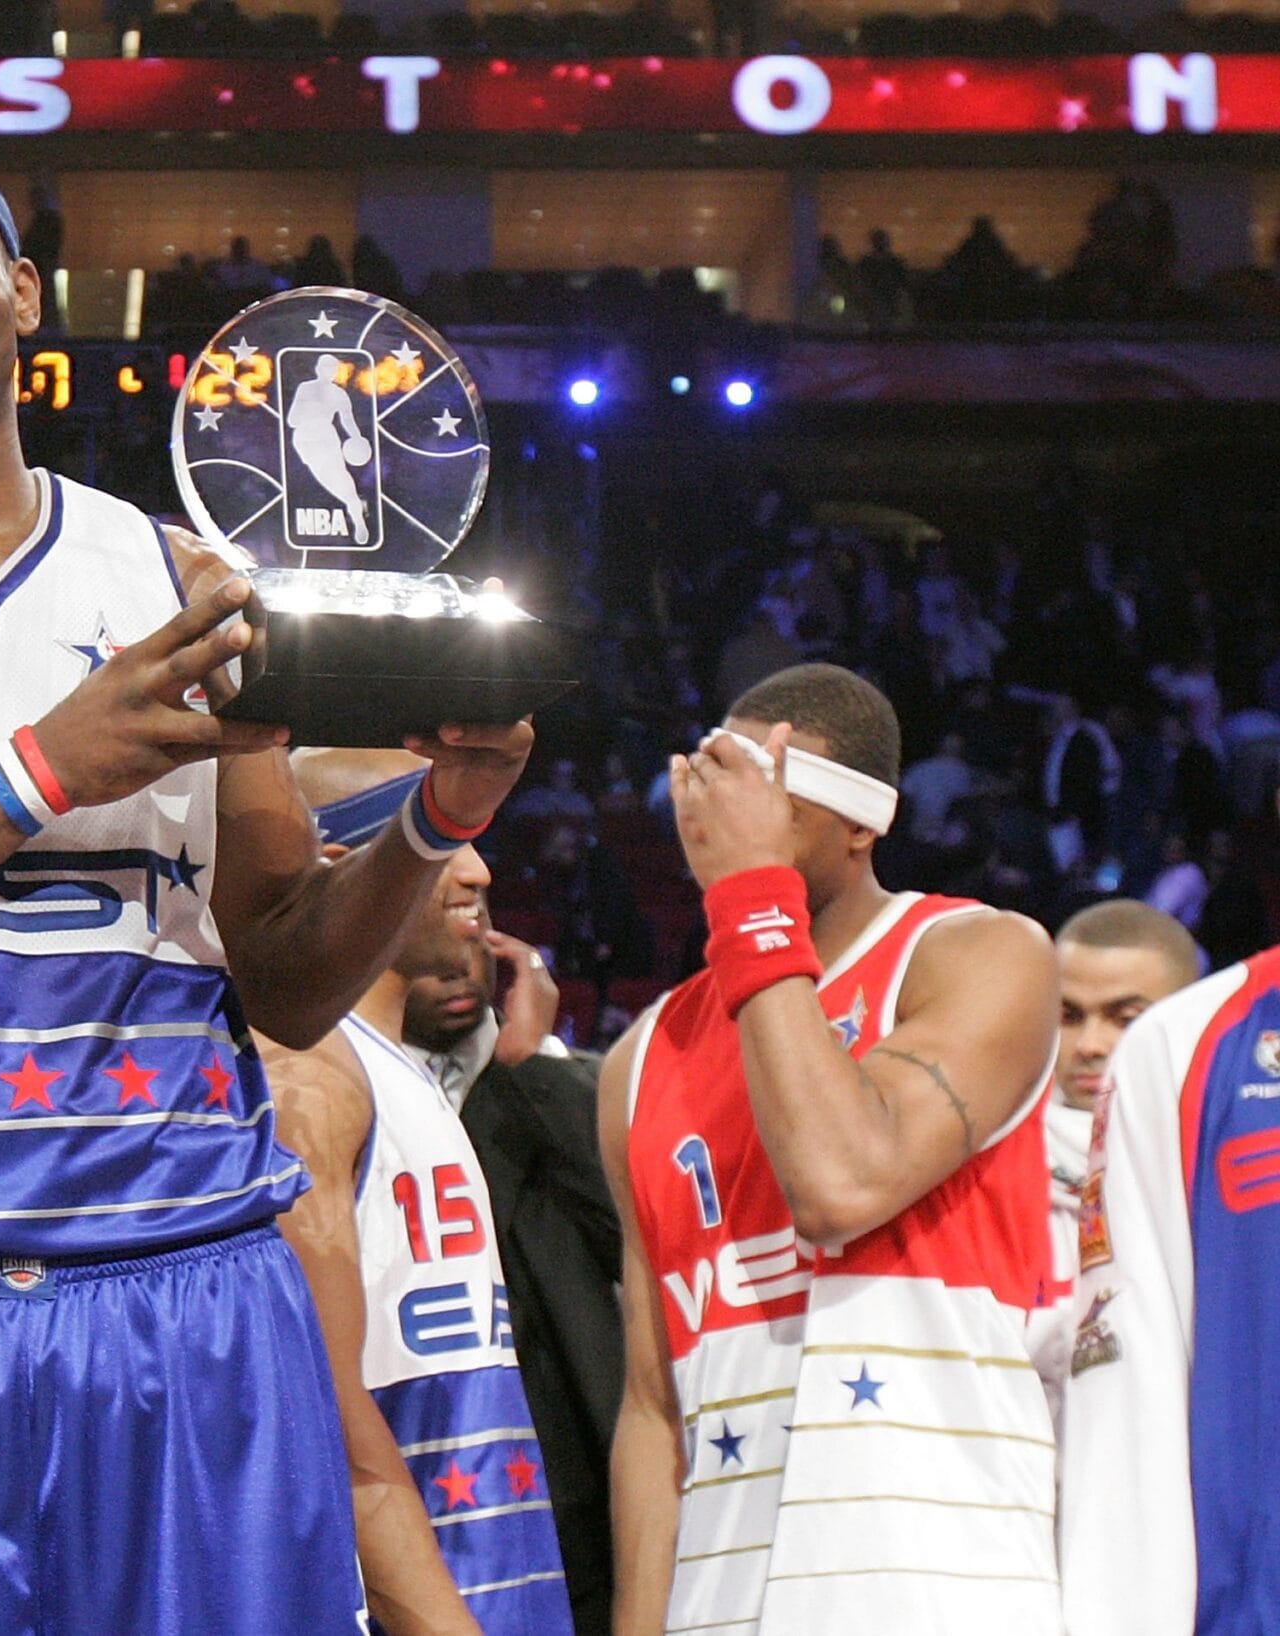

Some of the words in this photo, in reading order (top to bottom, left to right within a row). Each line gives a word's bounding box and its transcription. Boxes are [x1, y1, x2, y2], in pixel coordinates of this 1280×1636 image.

[295, 507, 350, 537] NBA
[392, 1163, 486, 1263] 15
[673, 1133, 722, 1229] 1
